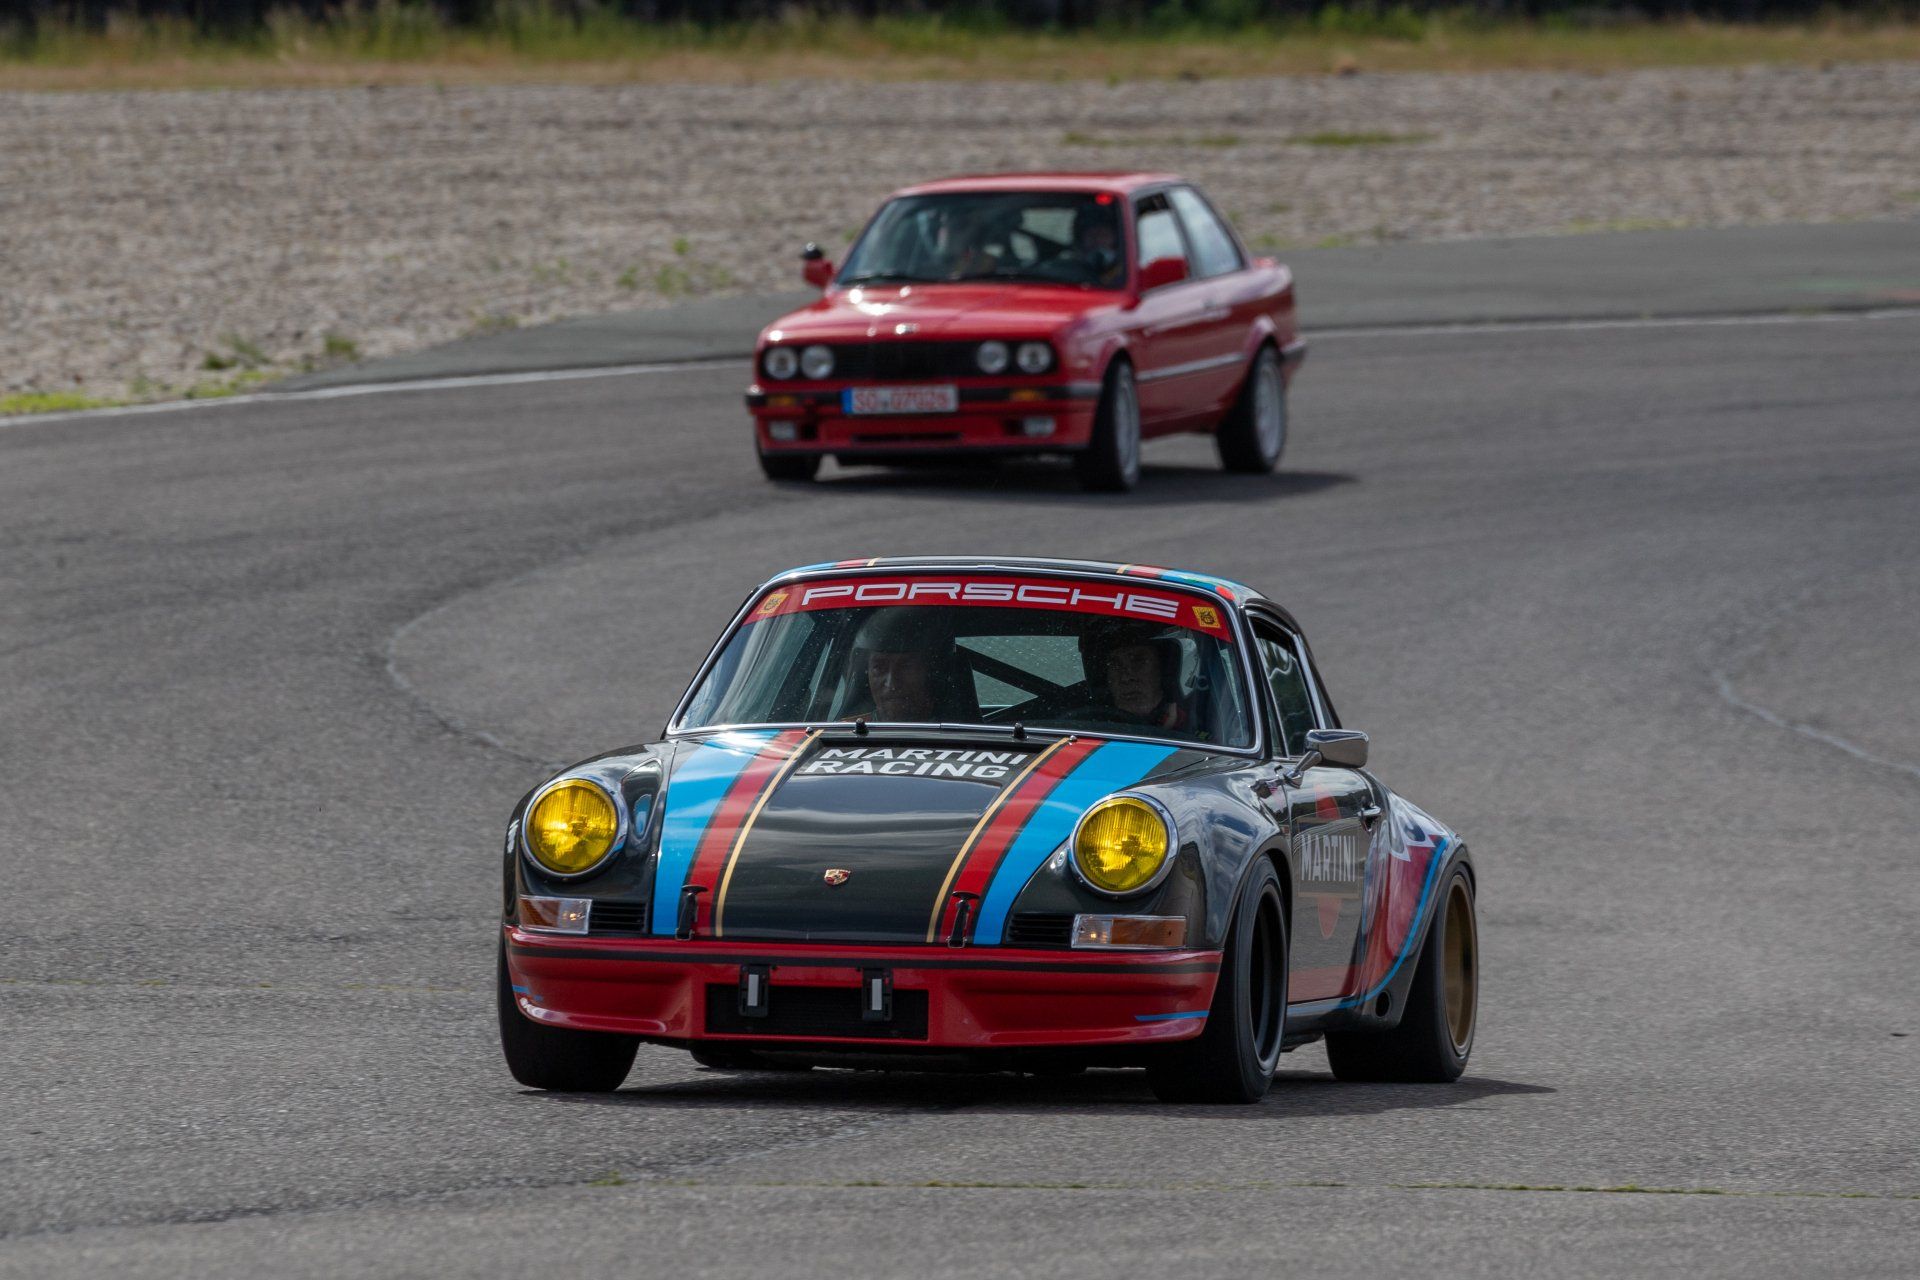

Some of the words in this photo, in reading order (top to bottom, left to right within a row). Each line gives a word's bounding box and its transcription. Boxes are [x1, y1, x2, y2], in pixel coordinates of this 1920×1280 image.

[801, 583, 1179, 618] PORSCHE
[804, 760, 1009, 778] RACING
[820, 748, 1027, 765] MARTINI
[1301, 834, 1356, 882] MARTINI
